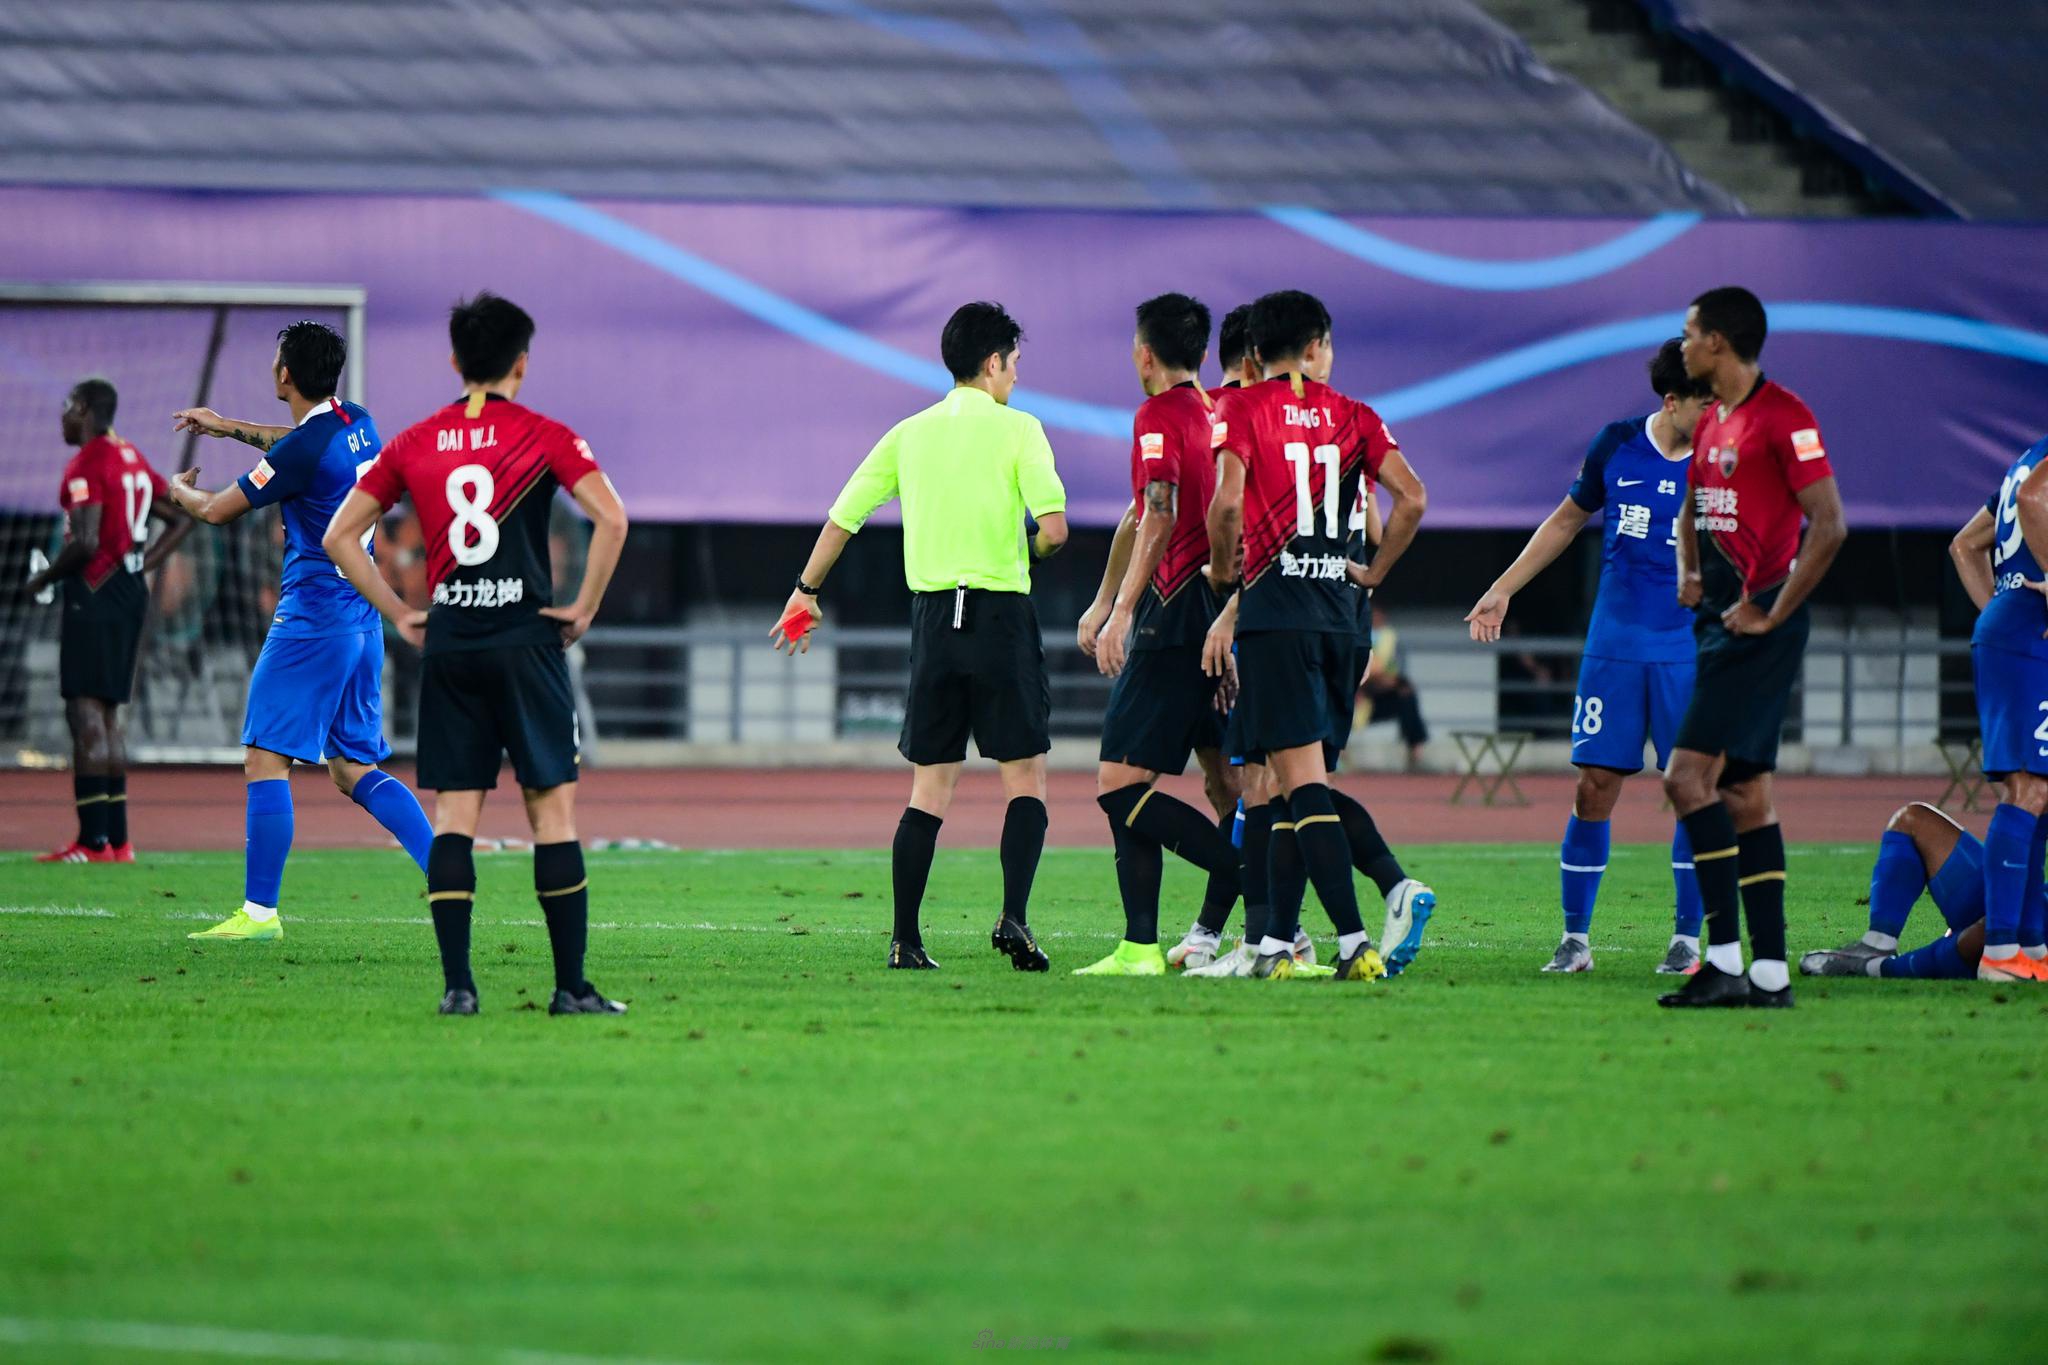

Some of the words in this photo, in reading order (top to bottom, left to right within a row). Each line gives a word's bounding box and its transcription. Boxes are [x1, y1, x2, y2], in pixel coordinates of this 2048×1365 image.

[437, 429, 463, 452] DAI
[122, 470, 153, 542] 12
[446, 464, 500, 566] 8
[1284, 442, 1340, 539] 11
[1572, 695, 1603, 735] 28
